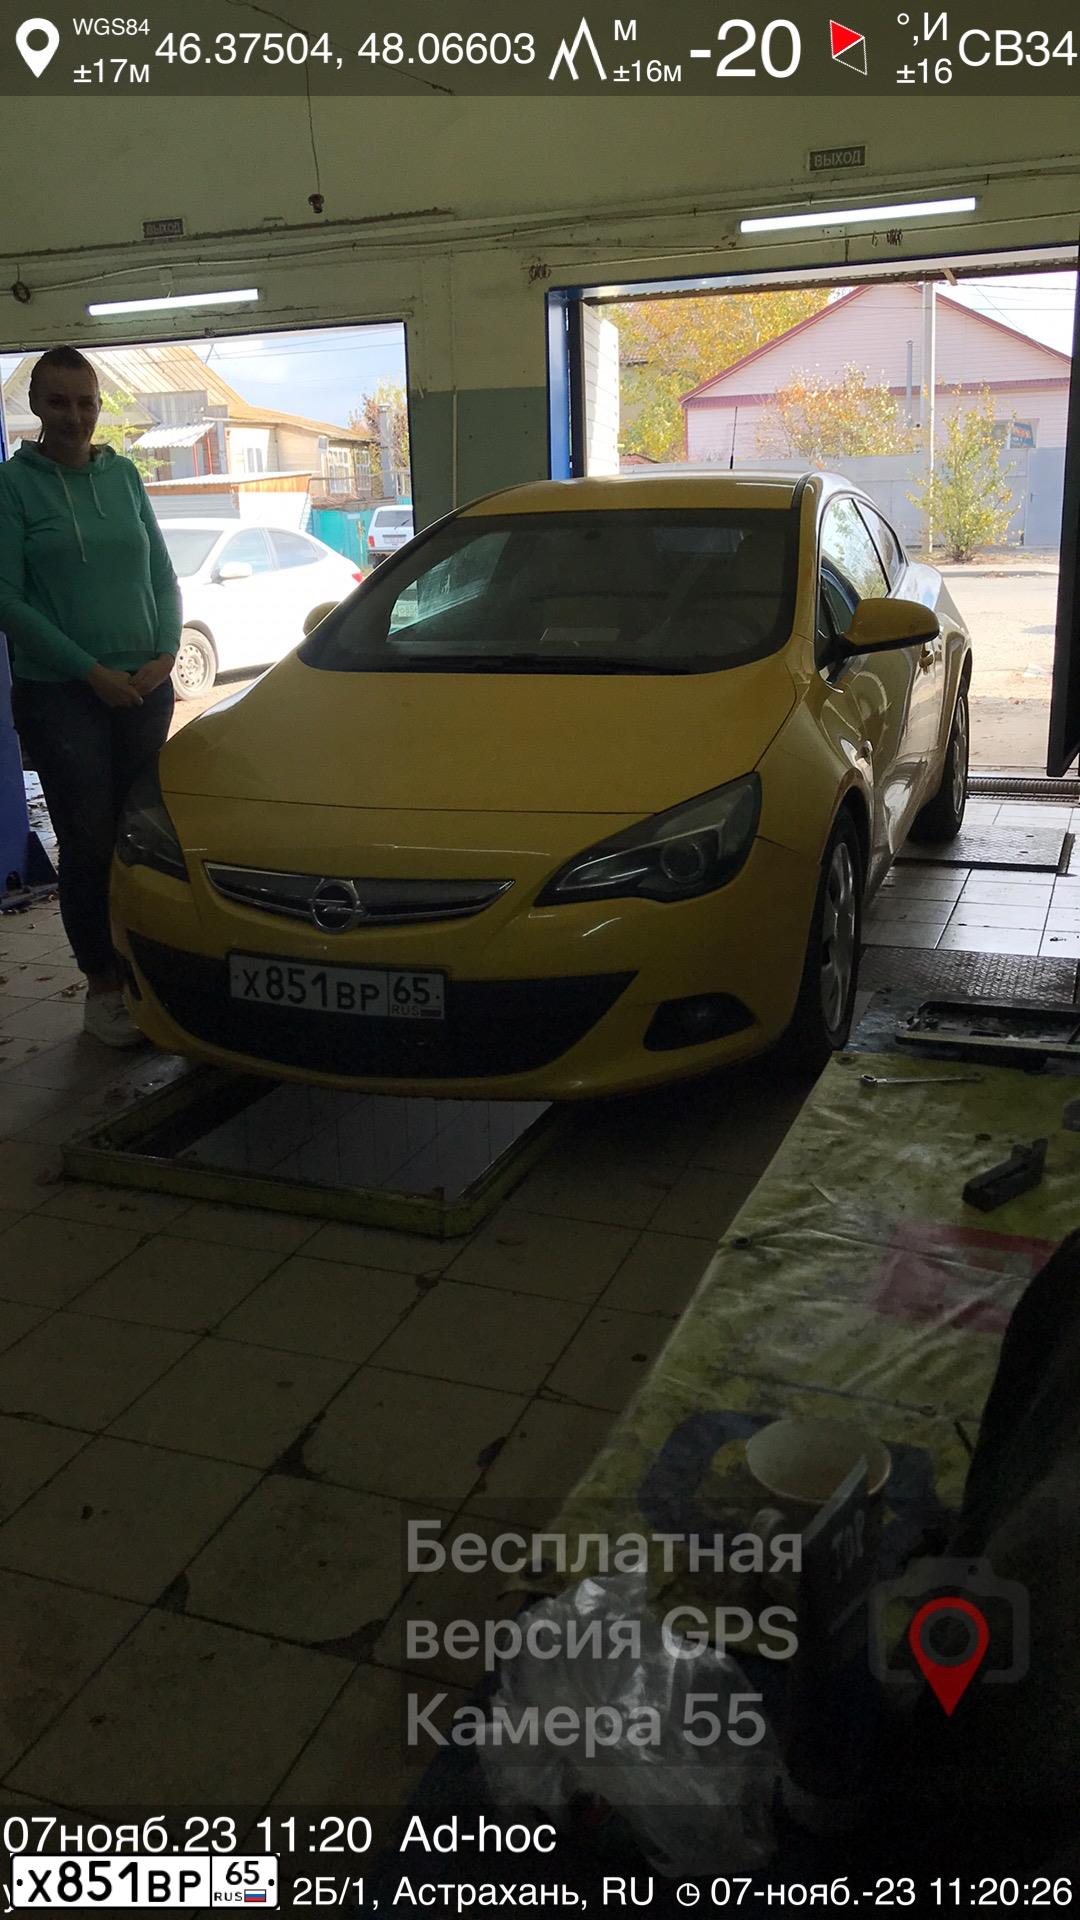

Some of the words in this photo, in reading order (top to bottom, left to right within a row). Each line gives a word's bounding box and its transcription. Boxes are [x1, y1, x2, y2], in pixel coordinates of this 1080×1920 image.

[813, 150, 862, 169] ВЫХОД
[393, 976, 431, 1005] 65
[391, 1004, 421, 1018] RUS
